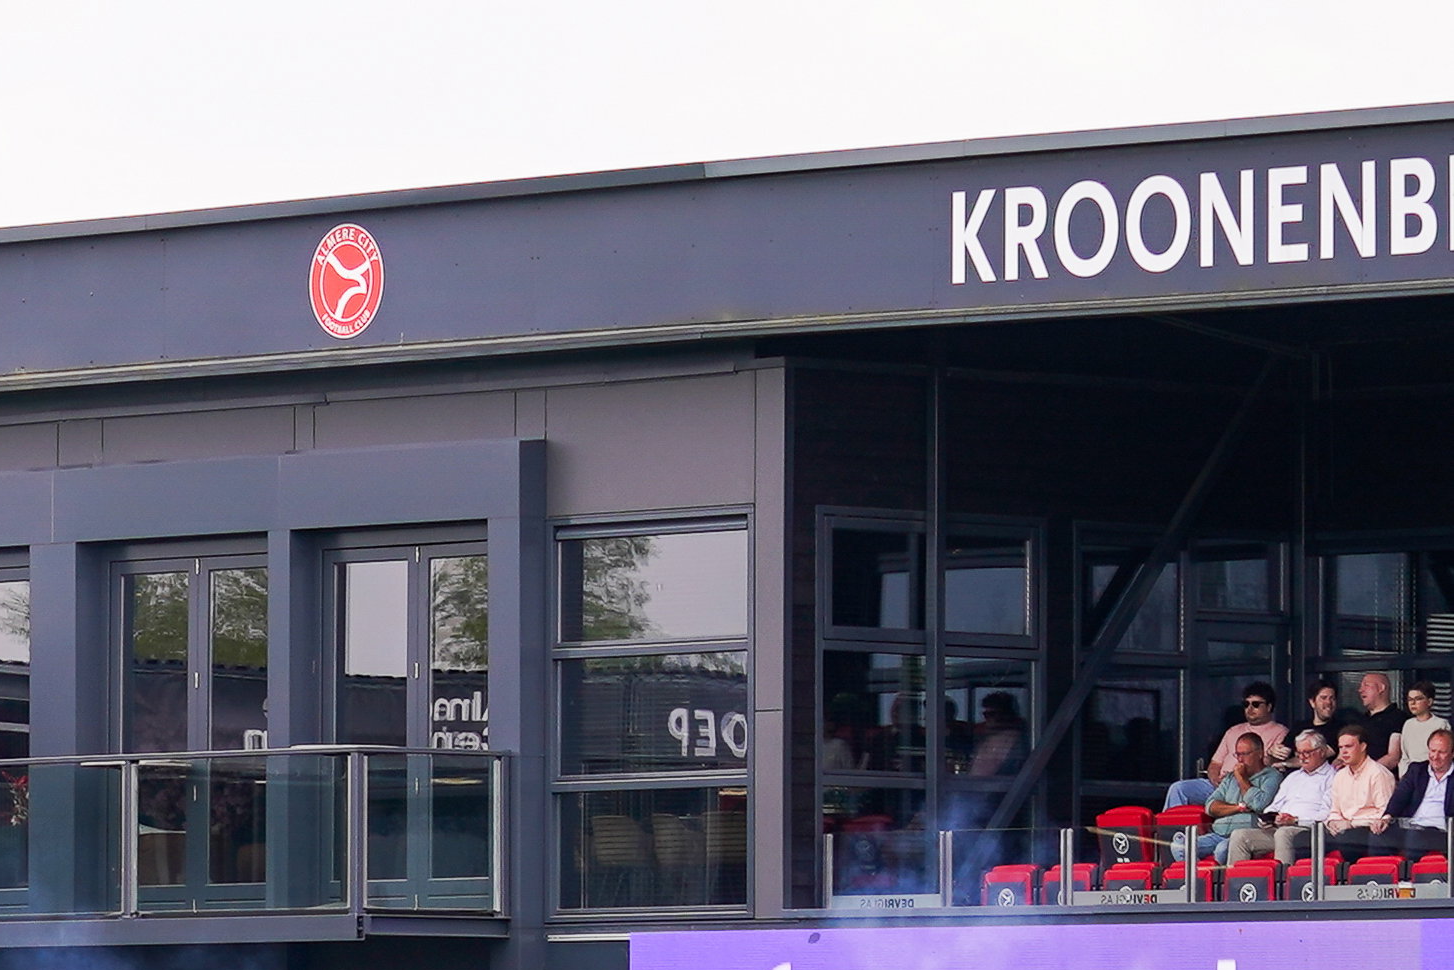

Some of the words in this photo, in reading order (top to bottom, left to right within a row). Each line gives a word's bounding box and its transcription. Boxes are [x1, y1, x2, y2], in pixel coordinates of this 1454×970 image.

[951, 154, 1454, 285] KROONENB
[316, 228, 356, 265] ALMERE
[357, 232, 379, 261] CITY
[321, 313, 355, 334] FOOTBALL
[354, 309, 371, 332] CLUB
